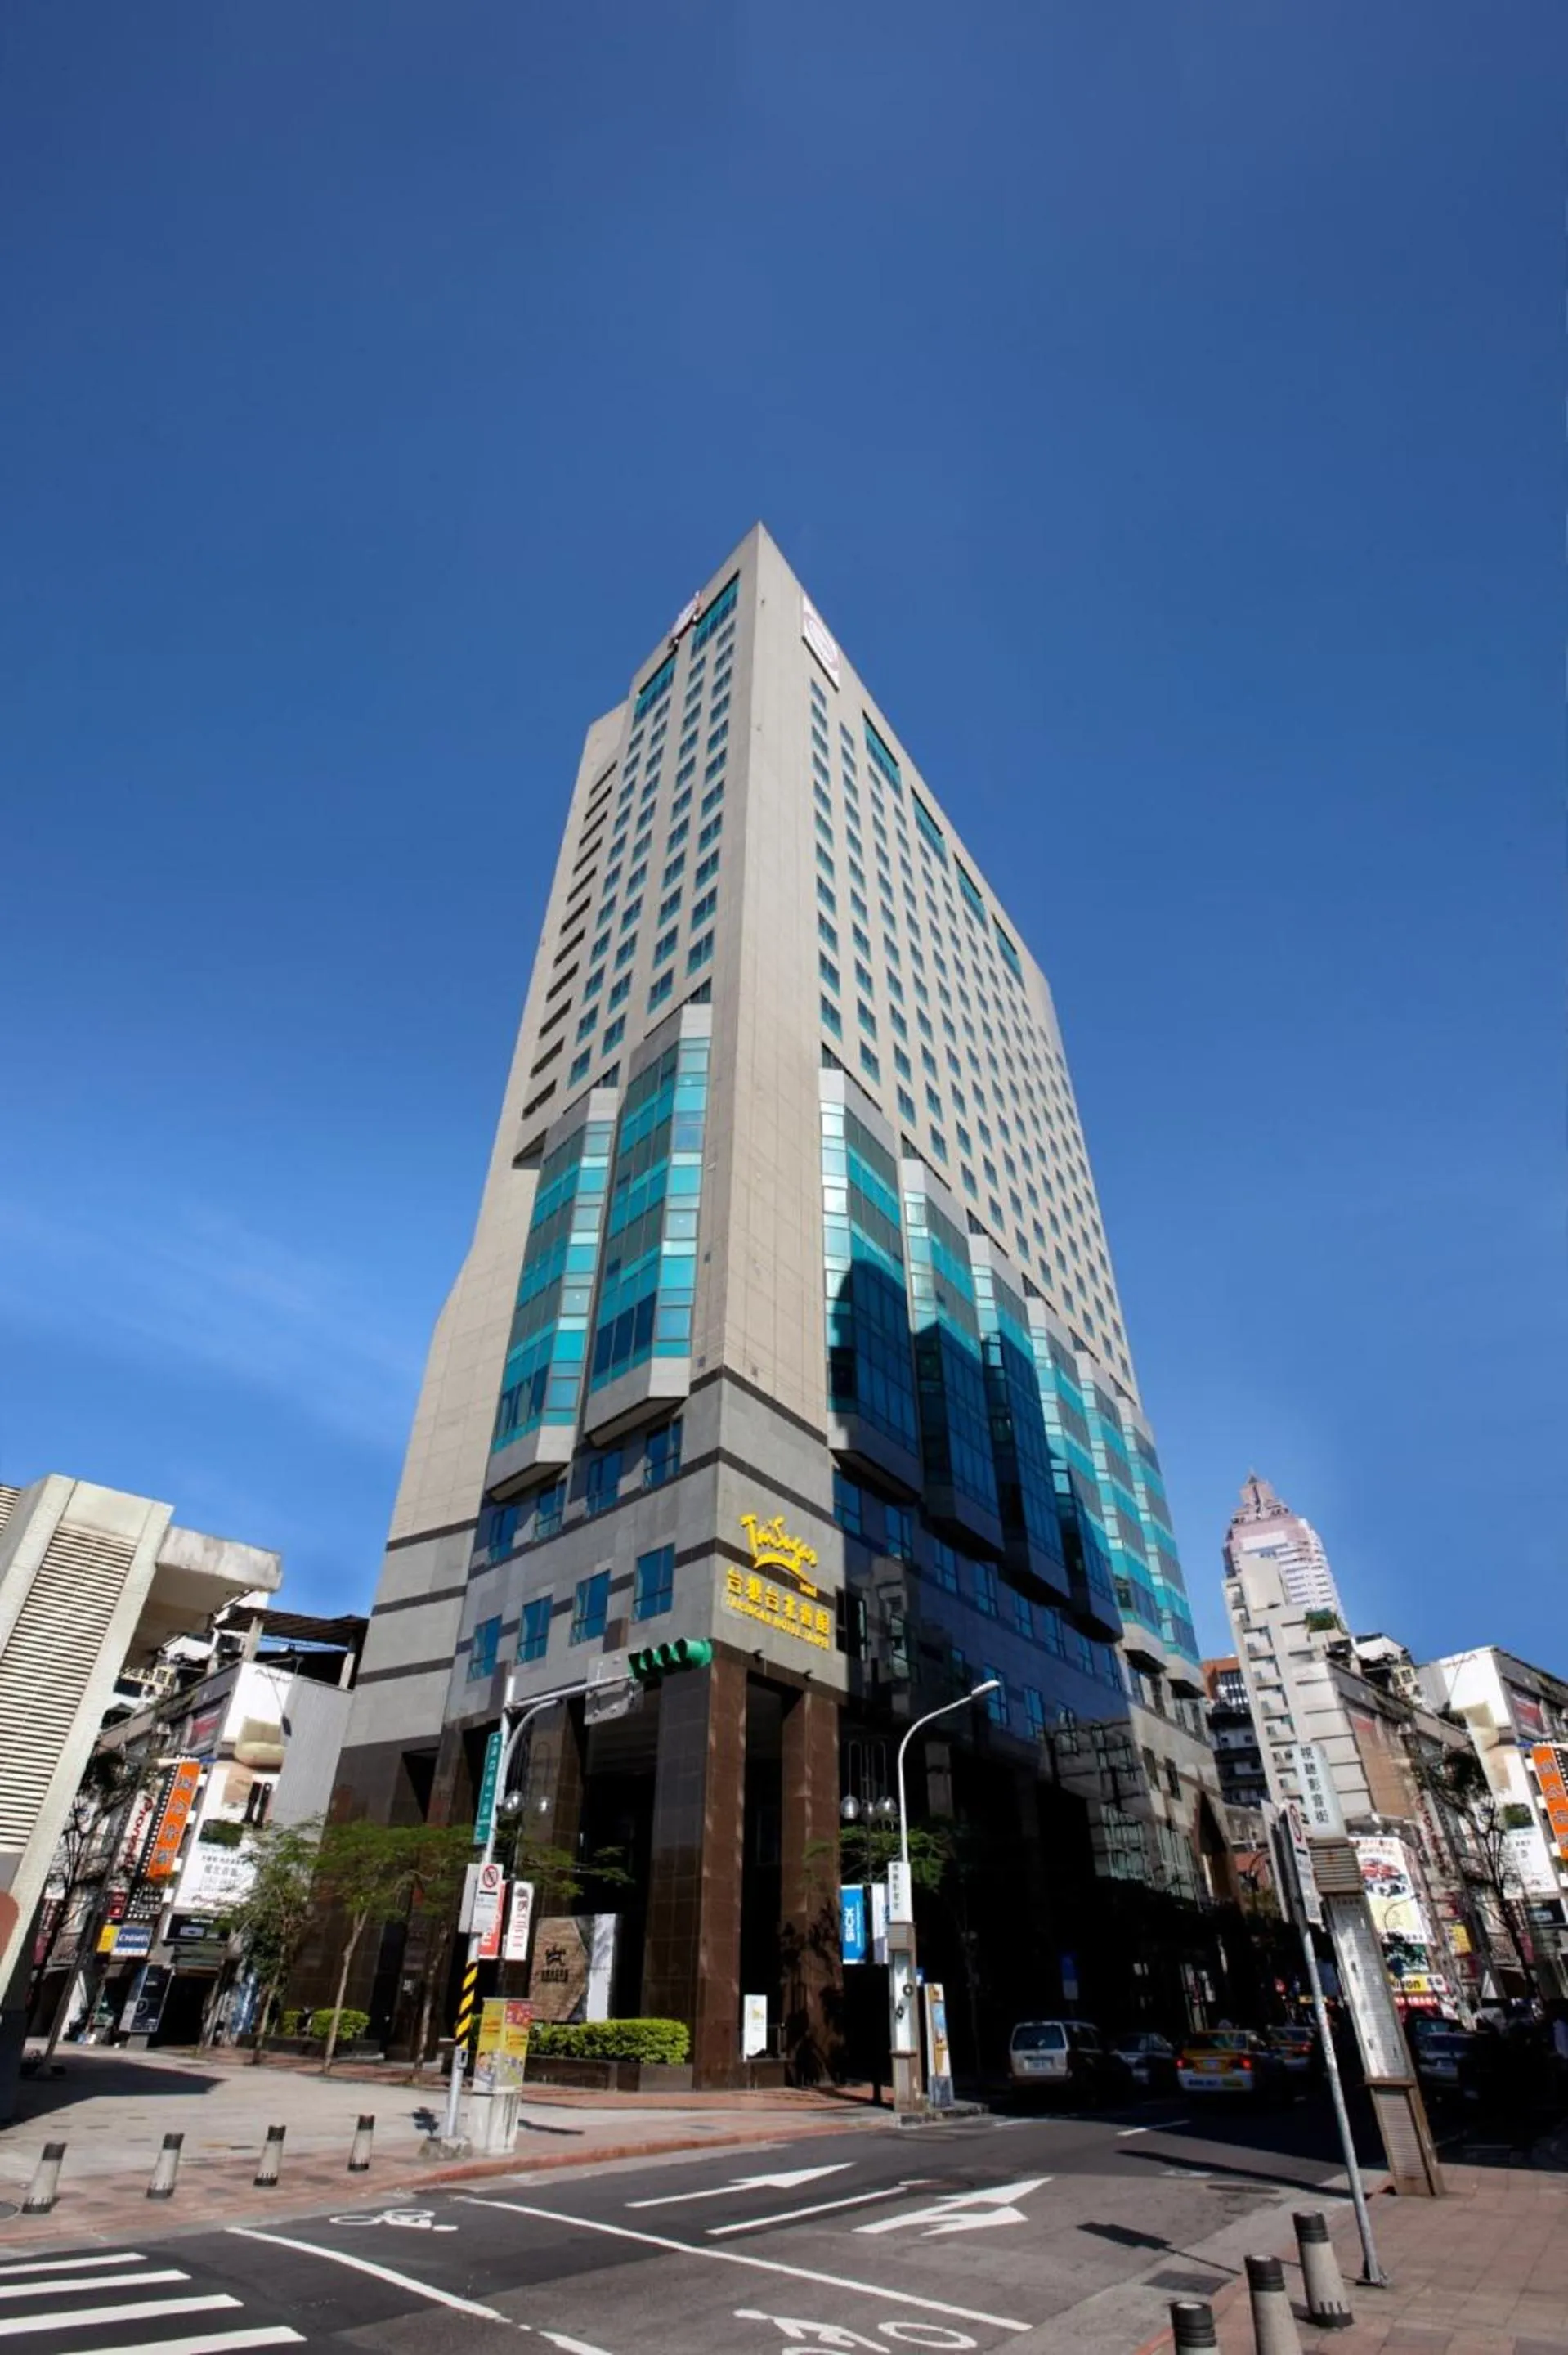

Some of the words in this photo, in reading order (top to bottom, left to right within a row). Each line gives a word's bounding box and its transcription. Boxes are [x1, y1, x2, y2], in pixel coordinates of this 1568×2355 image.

[1301, 1746, 1329, 1825] 視聽影音街
